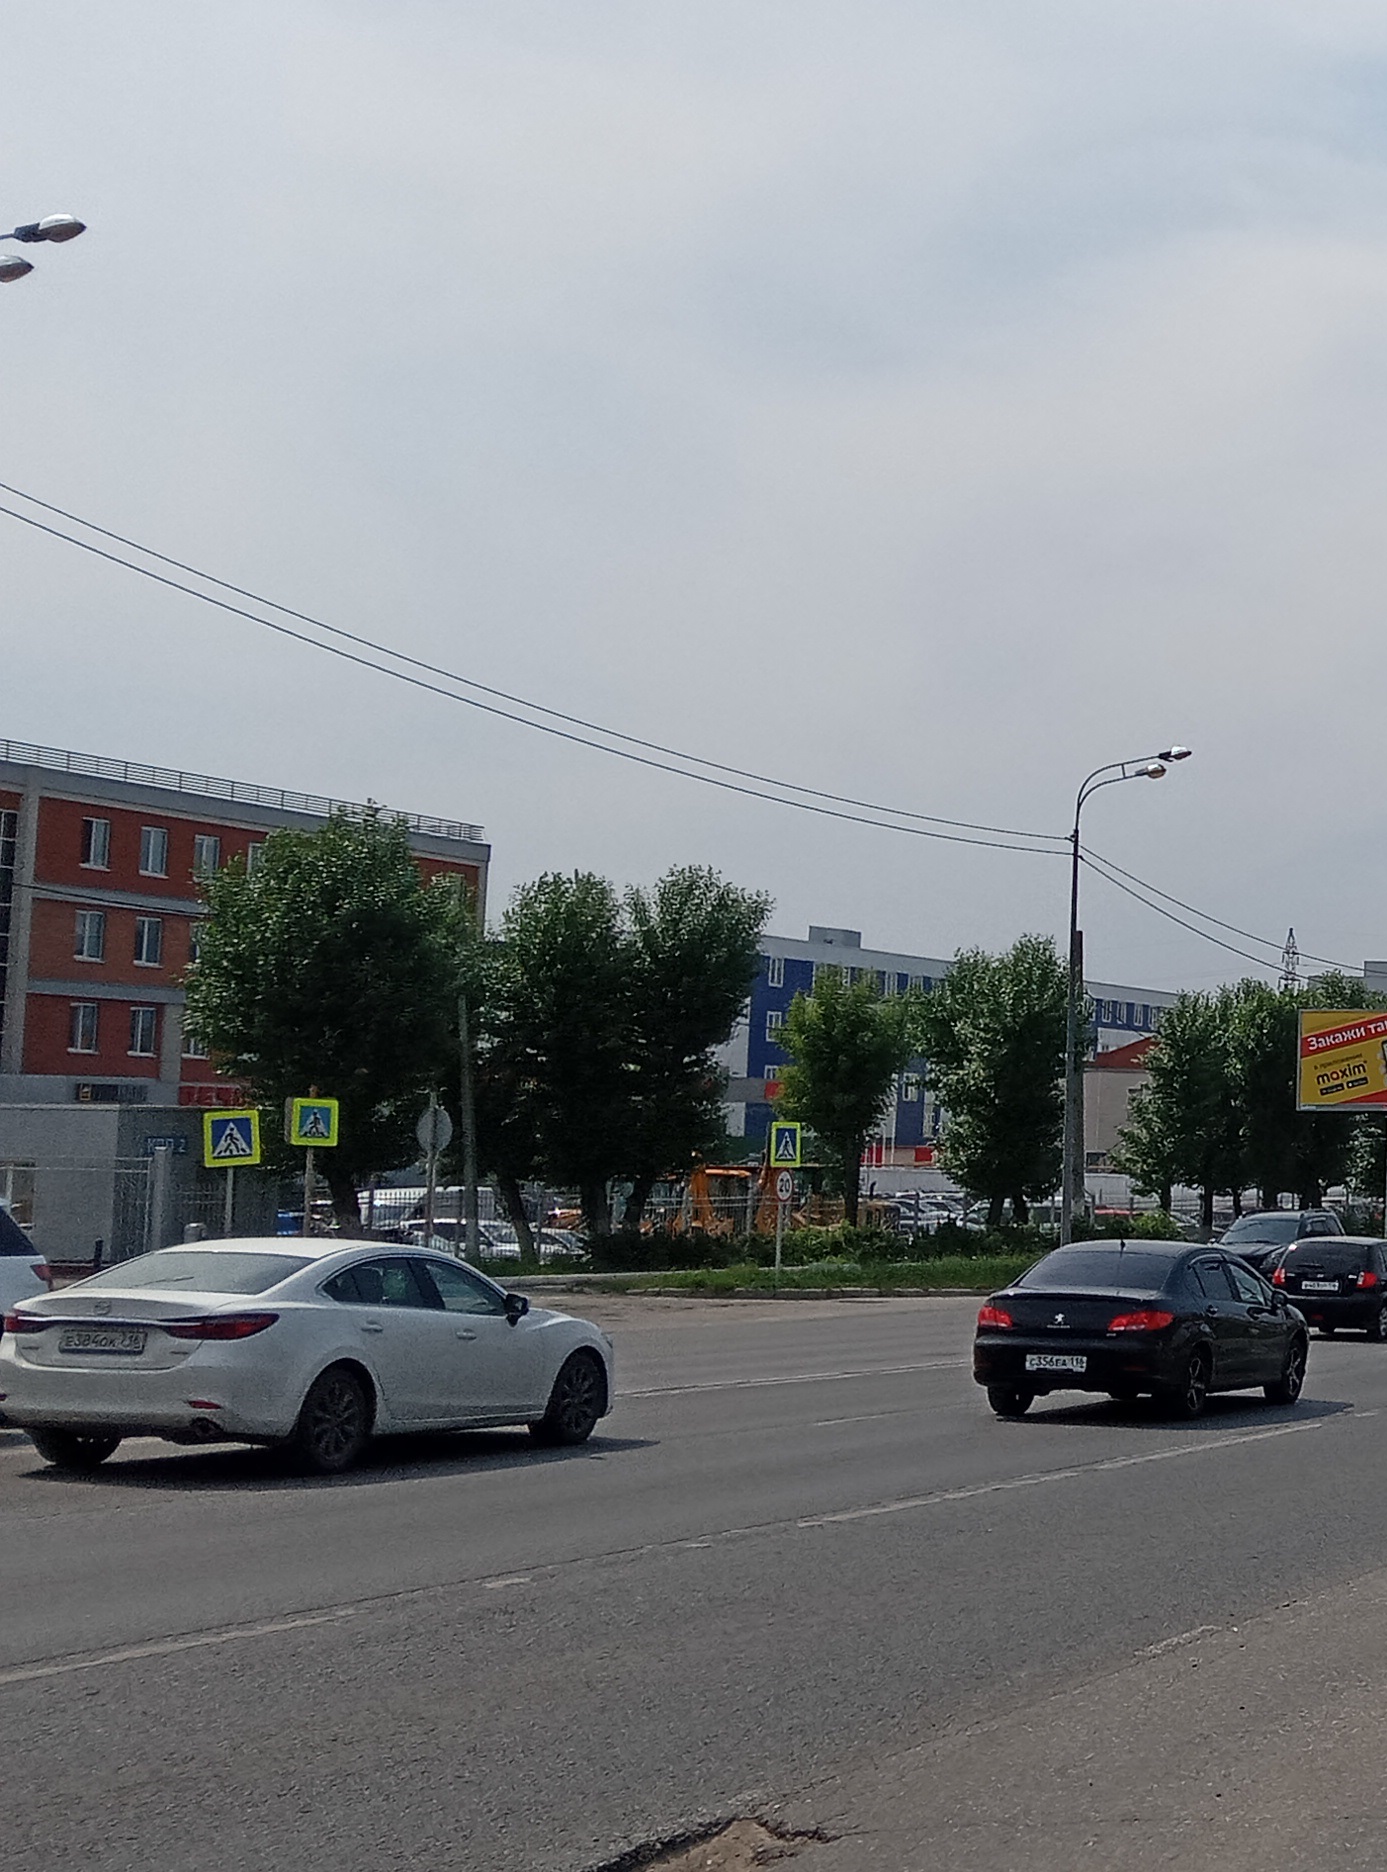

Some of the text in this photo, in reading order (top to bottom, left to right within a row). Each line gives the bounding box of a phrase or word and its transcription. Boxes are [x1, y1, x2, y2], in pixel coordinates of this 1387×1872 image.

[1307, 1027, 1366, 1051] Закажи
[1316, 1063, 1367, 1085] maxim
[779, 1178, 790, 1192] 20
